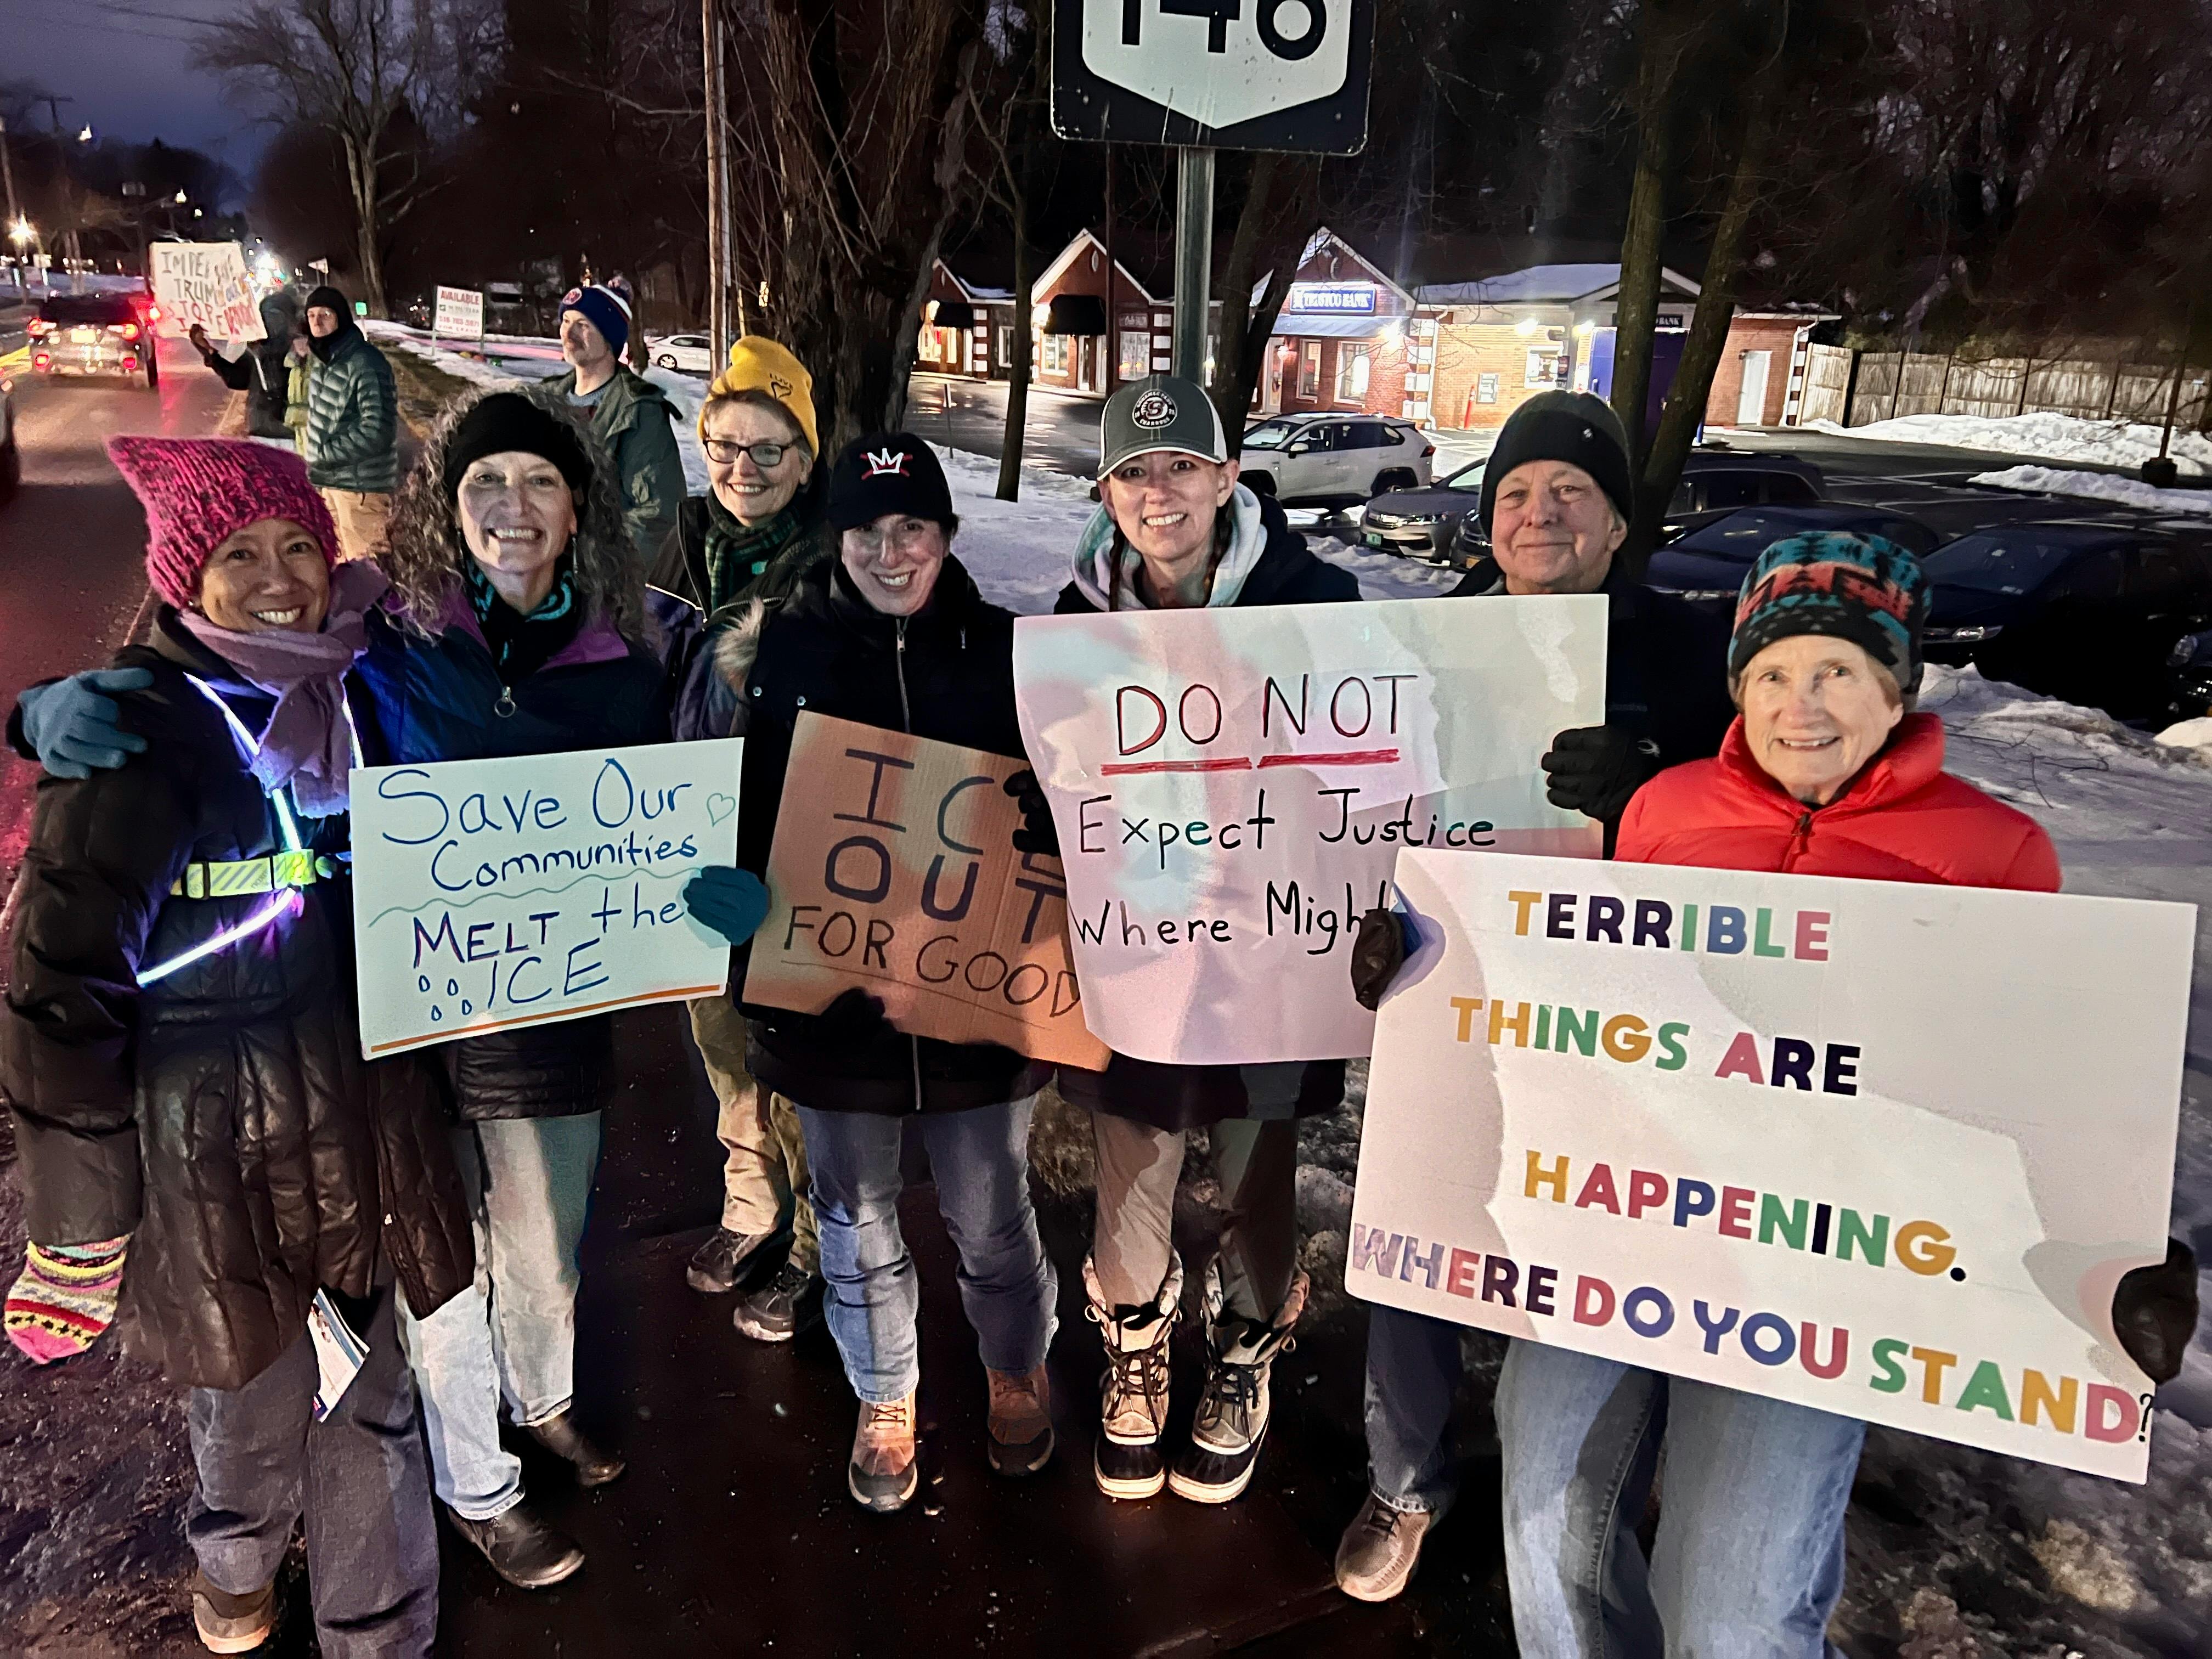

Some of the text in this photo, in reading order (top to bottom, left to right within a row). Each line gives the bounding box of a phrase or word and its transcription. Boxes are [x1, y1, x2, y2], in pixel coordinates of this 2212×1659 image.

[441, 290, 479, 305] AVAILABLE
[1342, 293, 1370, 307] BANK
[1659, 317, 1679, 325] BANK
[1116, 674, 1418, 756] DO NOT
[379, 758, 692, 844] Save Our
[833, 748, 1066, 884] IC
[1079, 788, 1496, 870] Expect Justice
[431, 831, 698, 891] Communities
[825, 836, 1066, 944] OUT
[414, 882, 684, 969] MELT the
[784, 906, 1080, 1018] FOR GOOD
[1068, 899, 1233, 946] Where
[1508, 890, 1831, 962] TERRIBLE
[488, 938, 610, 1009] ICE
[1450, 997, 1860, 1096] THINGS ARE
[1523, 1150, 1966, 1282] HAPPENING.
[1352, 1222, 2154, 1444] WHERE DO YOU STAND?
